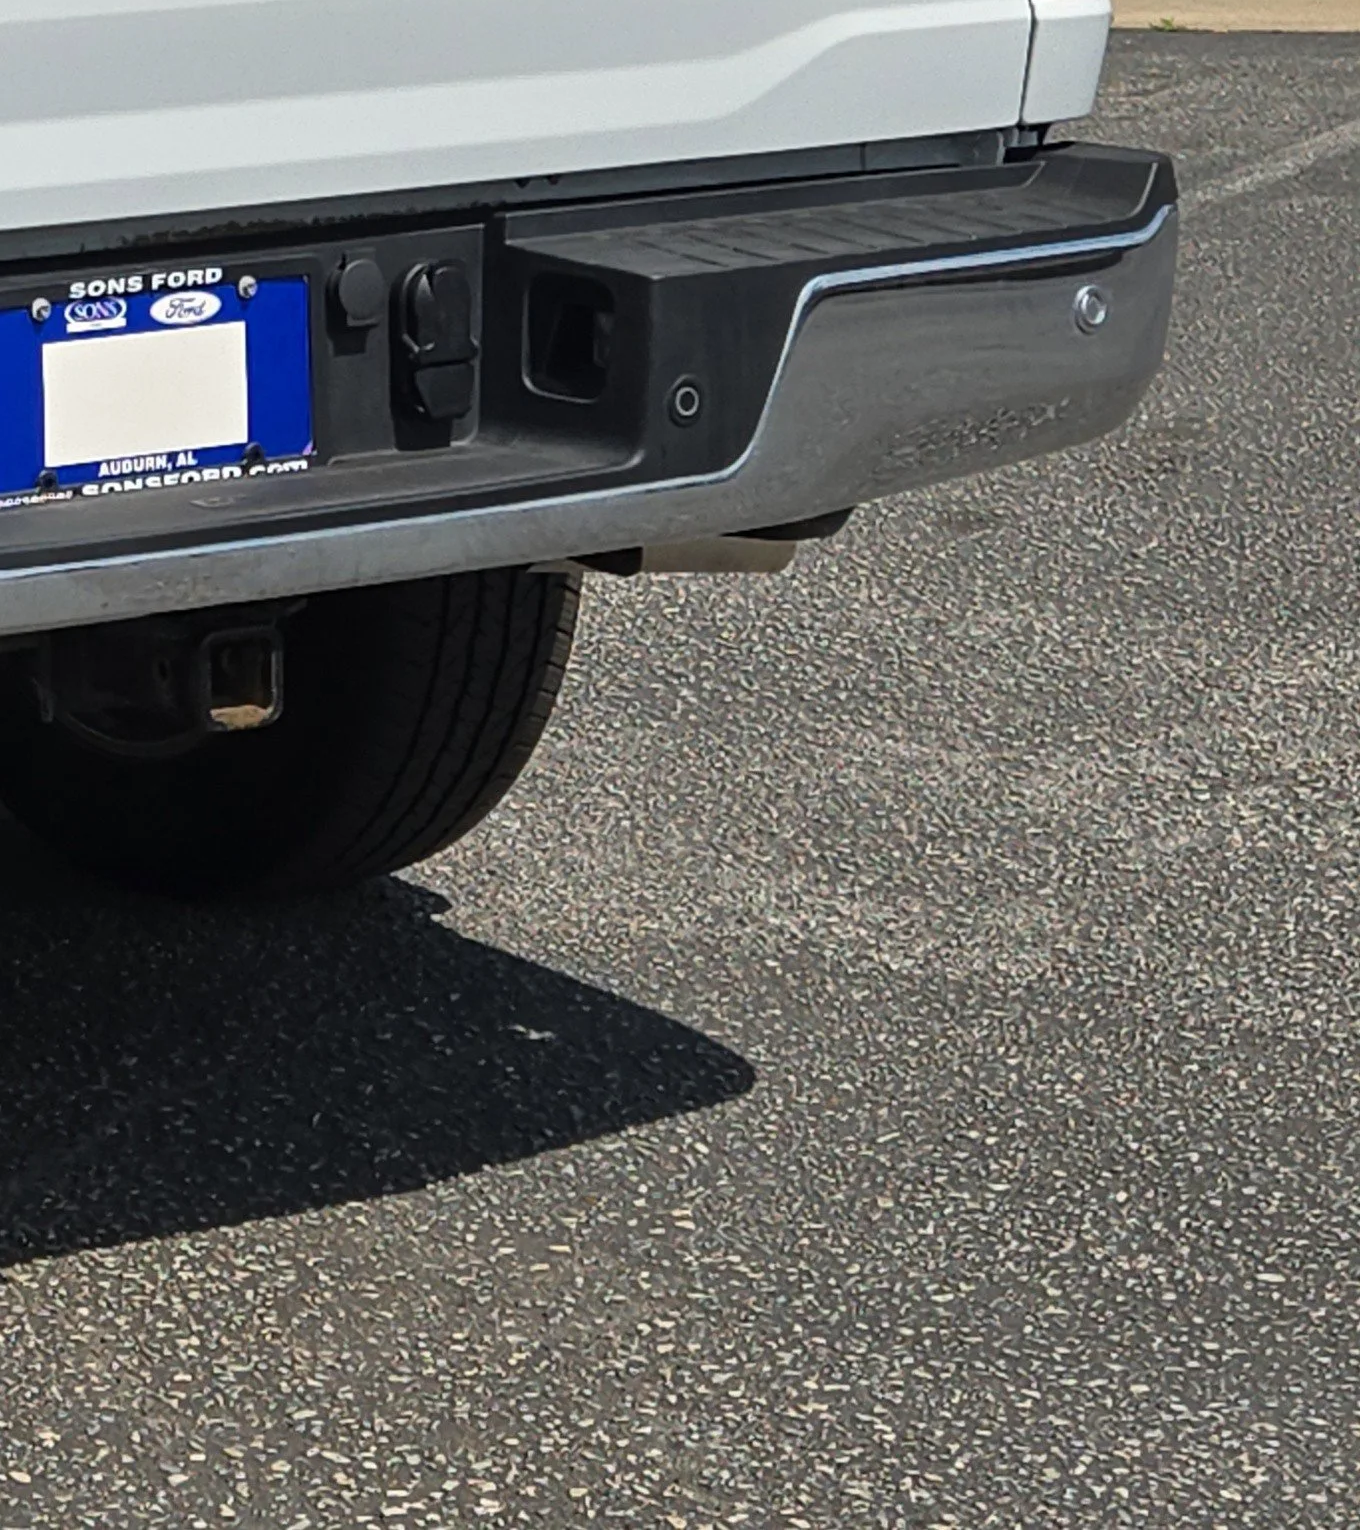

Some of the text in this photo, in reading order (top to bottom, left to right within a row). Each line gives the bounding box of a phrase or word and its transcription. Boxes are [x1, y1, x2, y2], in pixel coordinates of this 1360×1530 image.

[69, 268, 222, 299] SONS FORD
[73, 297, 206, 320] SONS Ford
[175, 451, 198, 466] AL
